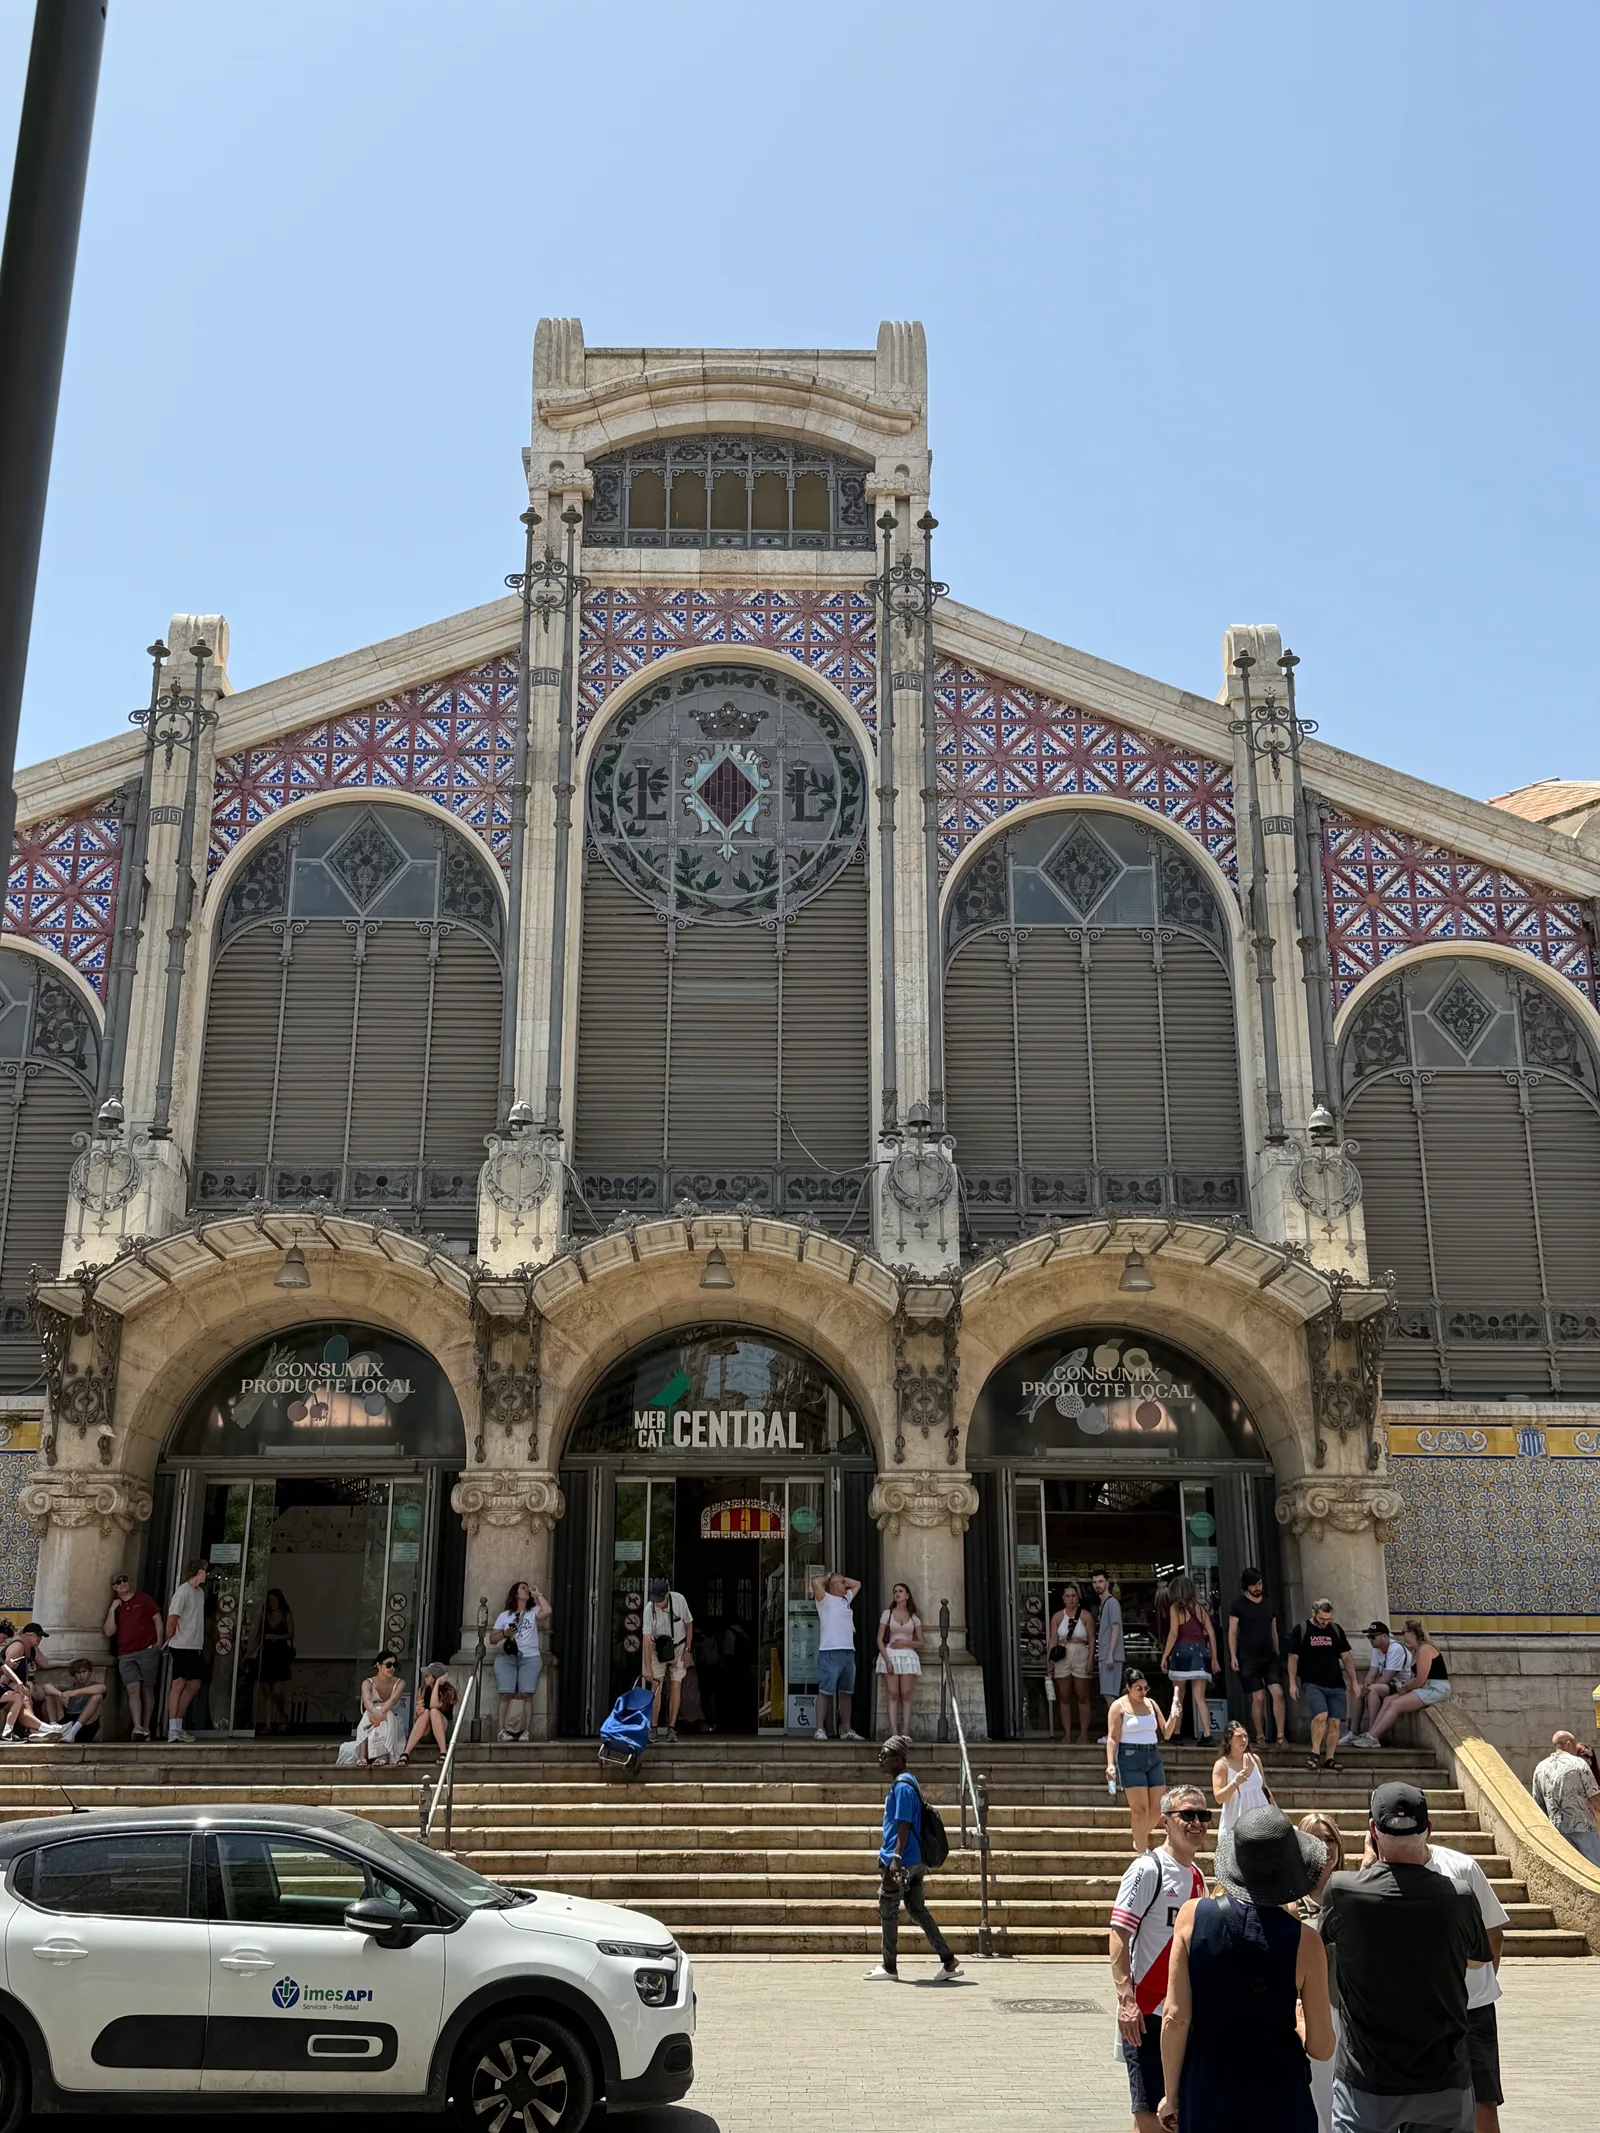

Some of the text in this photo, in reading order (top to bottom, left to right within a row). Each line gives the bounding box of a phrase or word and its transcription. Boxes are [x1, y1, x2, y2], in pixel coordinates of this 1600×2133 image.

[275, 1362, 384, 1377] CONSUMIX
[1053, 1366, 1160, 1382] CONSUMIX
[240, 1378, 416, 1394] PRODUCTE LOCAL
[1021, 1381, 1194, 1399] PRODUCTE LOCAL
[634, 1411, 666, 1429] MER
[638, 1429, 666, 1448] CAT
[673, 1410, 804, 1449] CENTRAL
[1127, 1866, 1144, 1908] NETSHOES
[303, 1984, 373, 2002] imesAPI
